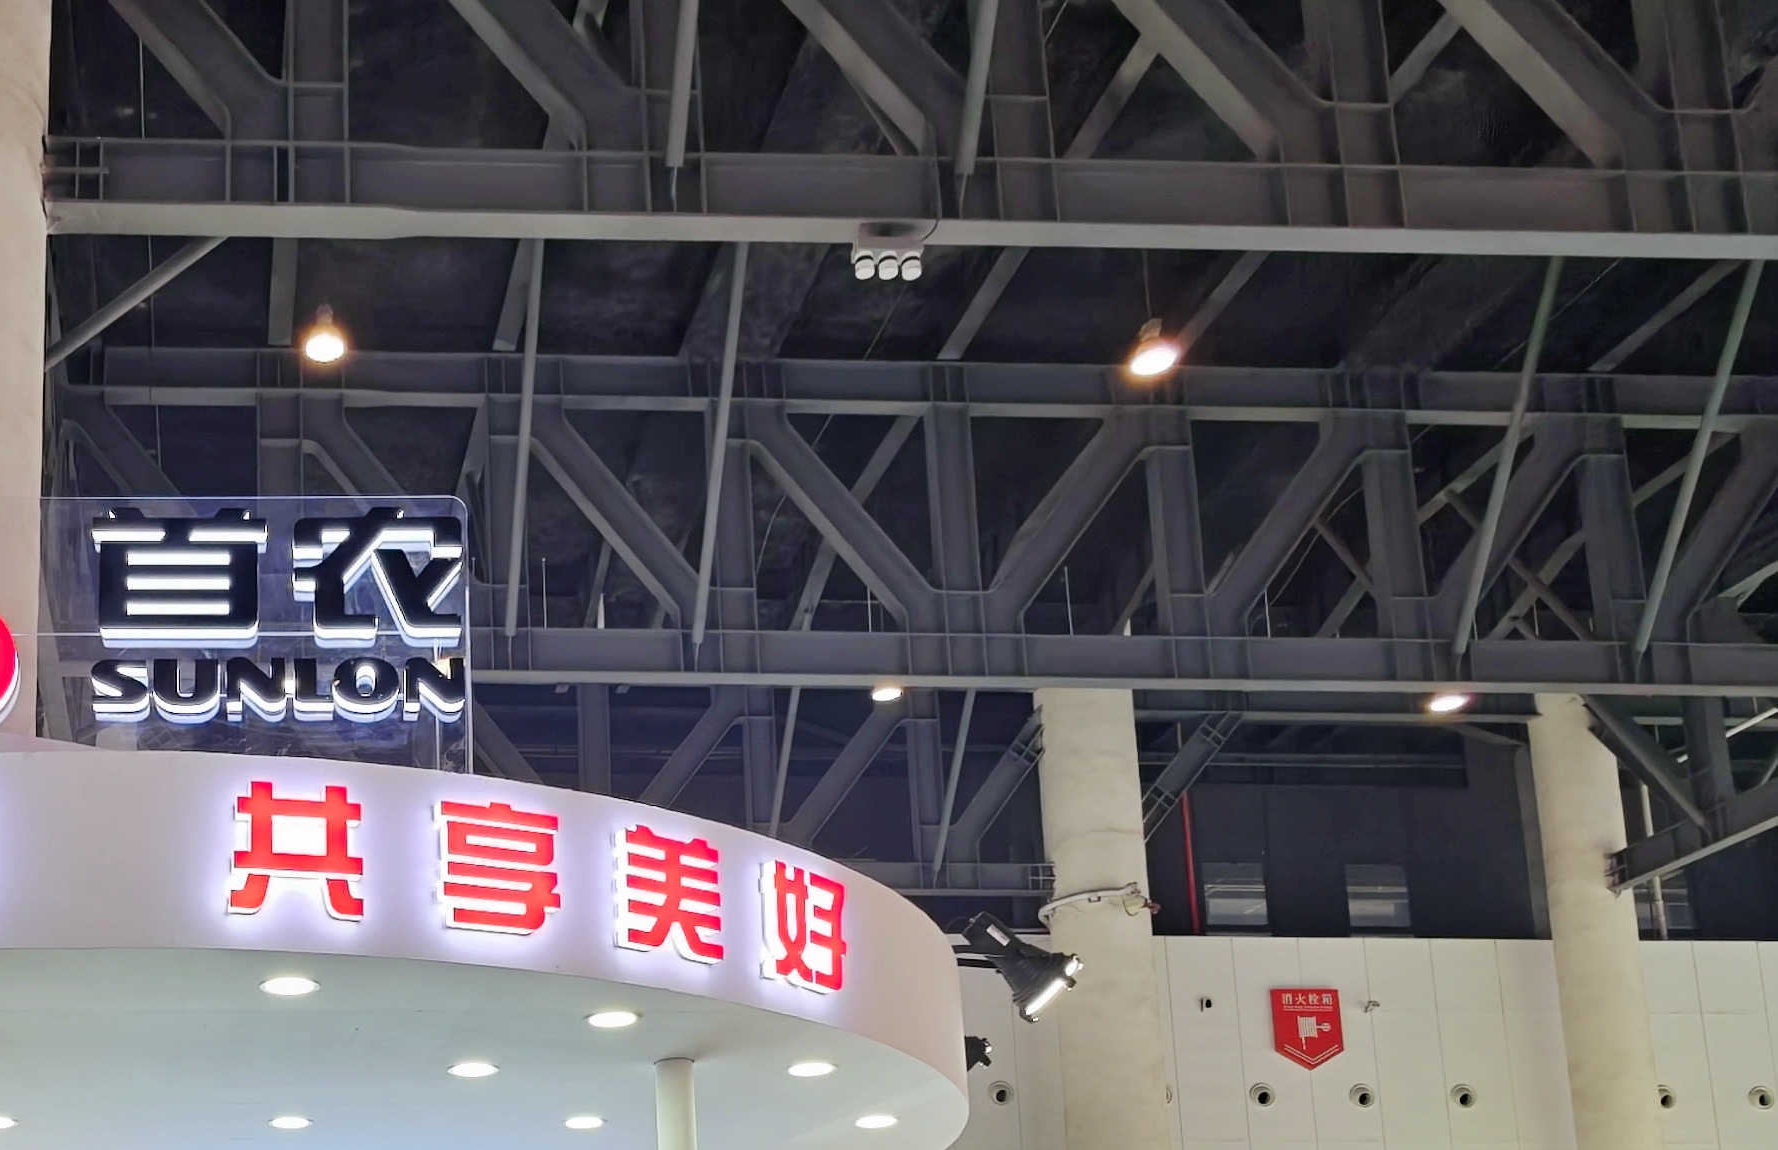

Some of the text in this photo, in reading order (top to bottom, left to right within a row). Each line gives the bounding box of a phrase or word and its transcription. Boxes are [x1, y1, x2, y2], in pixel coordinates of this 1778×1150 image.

[90, 505, 465, 649] 首农
[89, 656, 467, 725] SUNLON
[225, 780, 849, 995] 共享美好
[1281, 993, 1334, 1006] 消火栓箱
